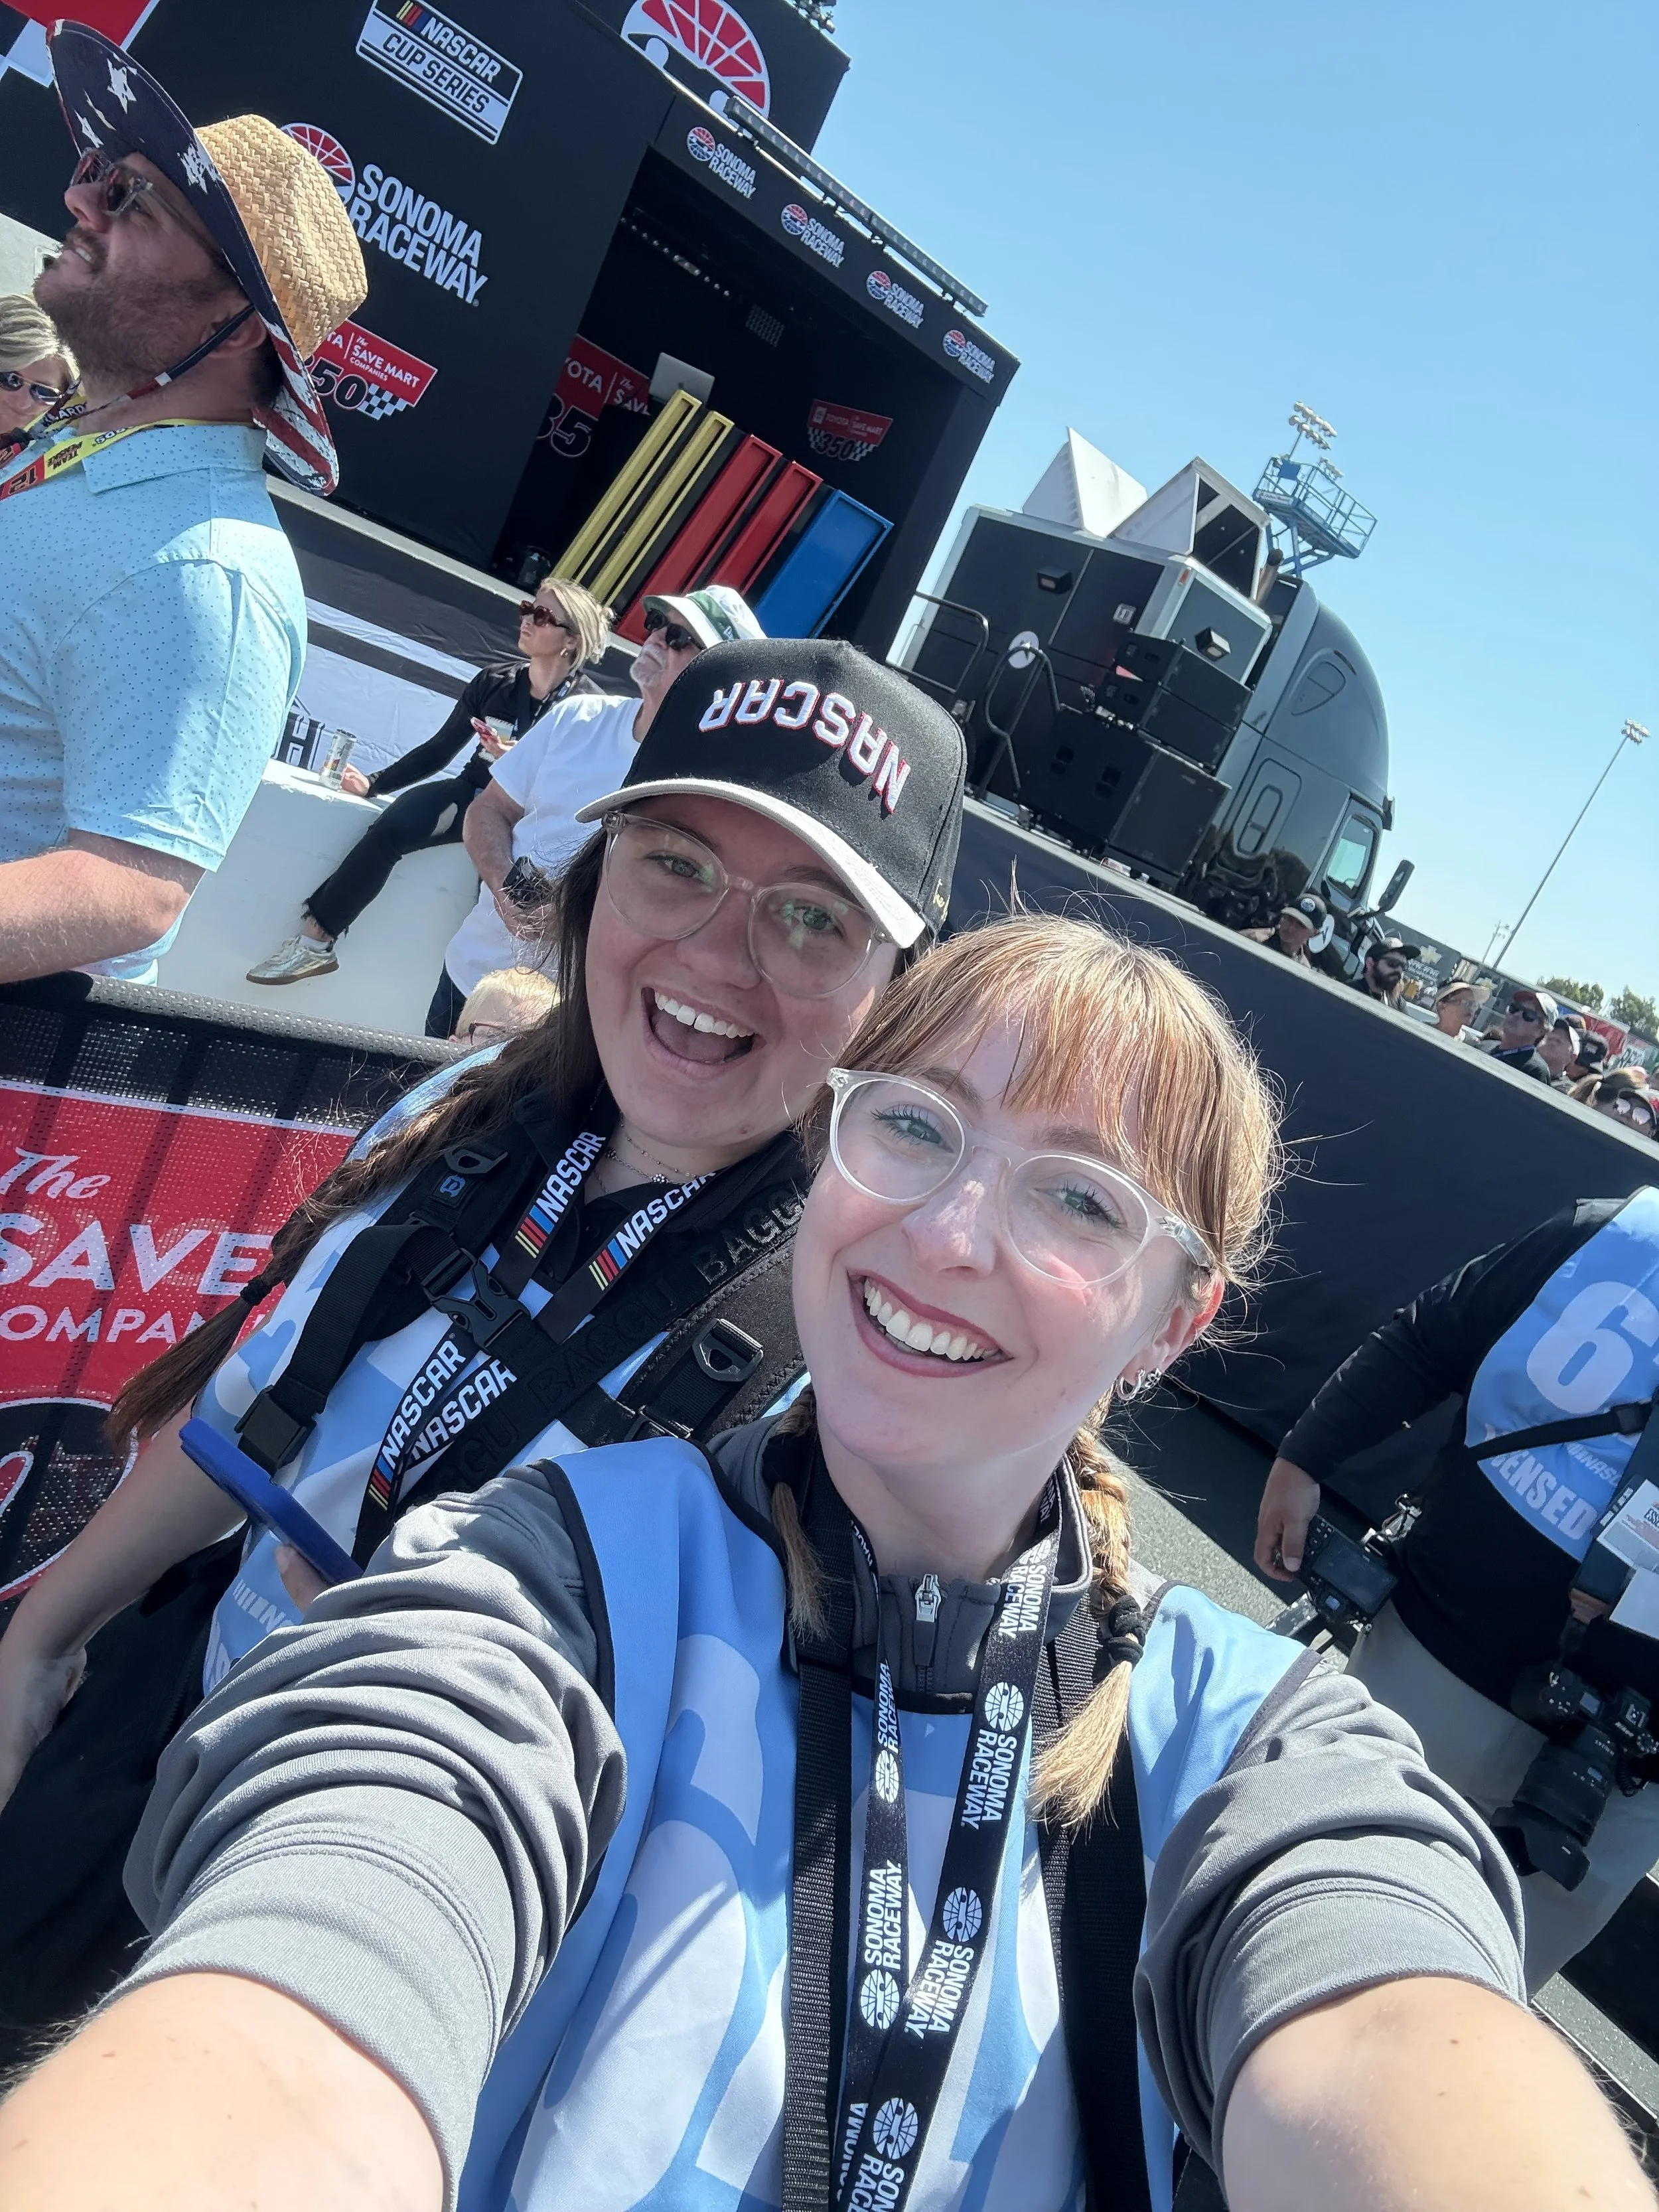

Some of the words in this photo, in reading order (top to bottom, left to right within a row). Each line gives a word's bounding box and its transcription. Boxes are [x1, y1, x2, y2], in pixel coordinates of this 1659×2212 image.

[382, 33, 426, 66] CUP
[422, 59, 490, 113] SERIES
[421, 17, 501, 83] NASCAR
[708, 157, 757, 199] RACEWAY
[715, 143, 757, 185] SONOMA
[349, 196, 488, 304] RACEWAY
[357, 163, 482, 268] SONOMA
[800, 230, 845, 268] RACEWAY
[807, 218, 845, 255] SONOMA
[883, 294, 924, 329] RACEWAY
[891, 283, 924, 316] SONOMA
[350, 356, 388, 382] COMPANIES
[352, 344, 384, 369] SAVE
[385, 362, 421, 388] MART
[356, 335, 368, 347] The
[565, 357, 603, 394] OTA
[304, 354, 369, 409] 50
[697, 677, 912, 814] NASCAR
[0, 1147, 111, 1199] The
[536, 1132, 606, 1223] NASCAR
[0, 1213, 274, 1297] SAVE
[381, 1340, 467, 1470] NASCAR
[998, 1566, 1029, 1639] RACEWAY
[1018, 1564, 1047, 1631] SONOMA
[877, 1662, 889, 1747] SONOMA
[962, 1728, 997, 1831] RACEWAY
[983, 1733, 1018, 1822] SONOMA
[864, 1869, 887, 1966] SONOMA
[883, 1860, 902, 1970] RACEWAY
[906, 1939, 952, 2040] RACEWAY
[928, 1945, 975, 2035] SONOMA
